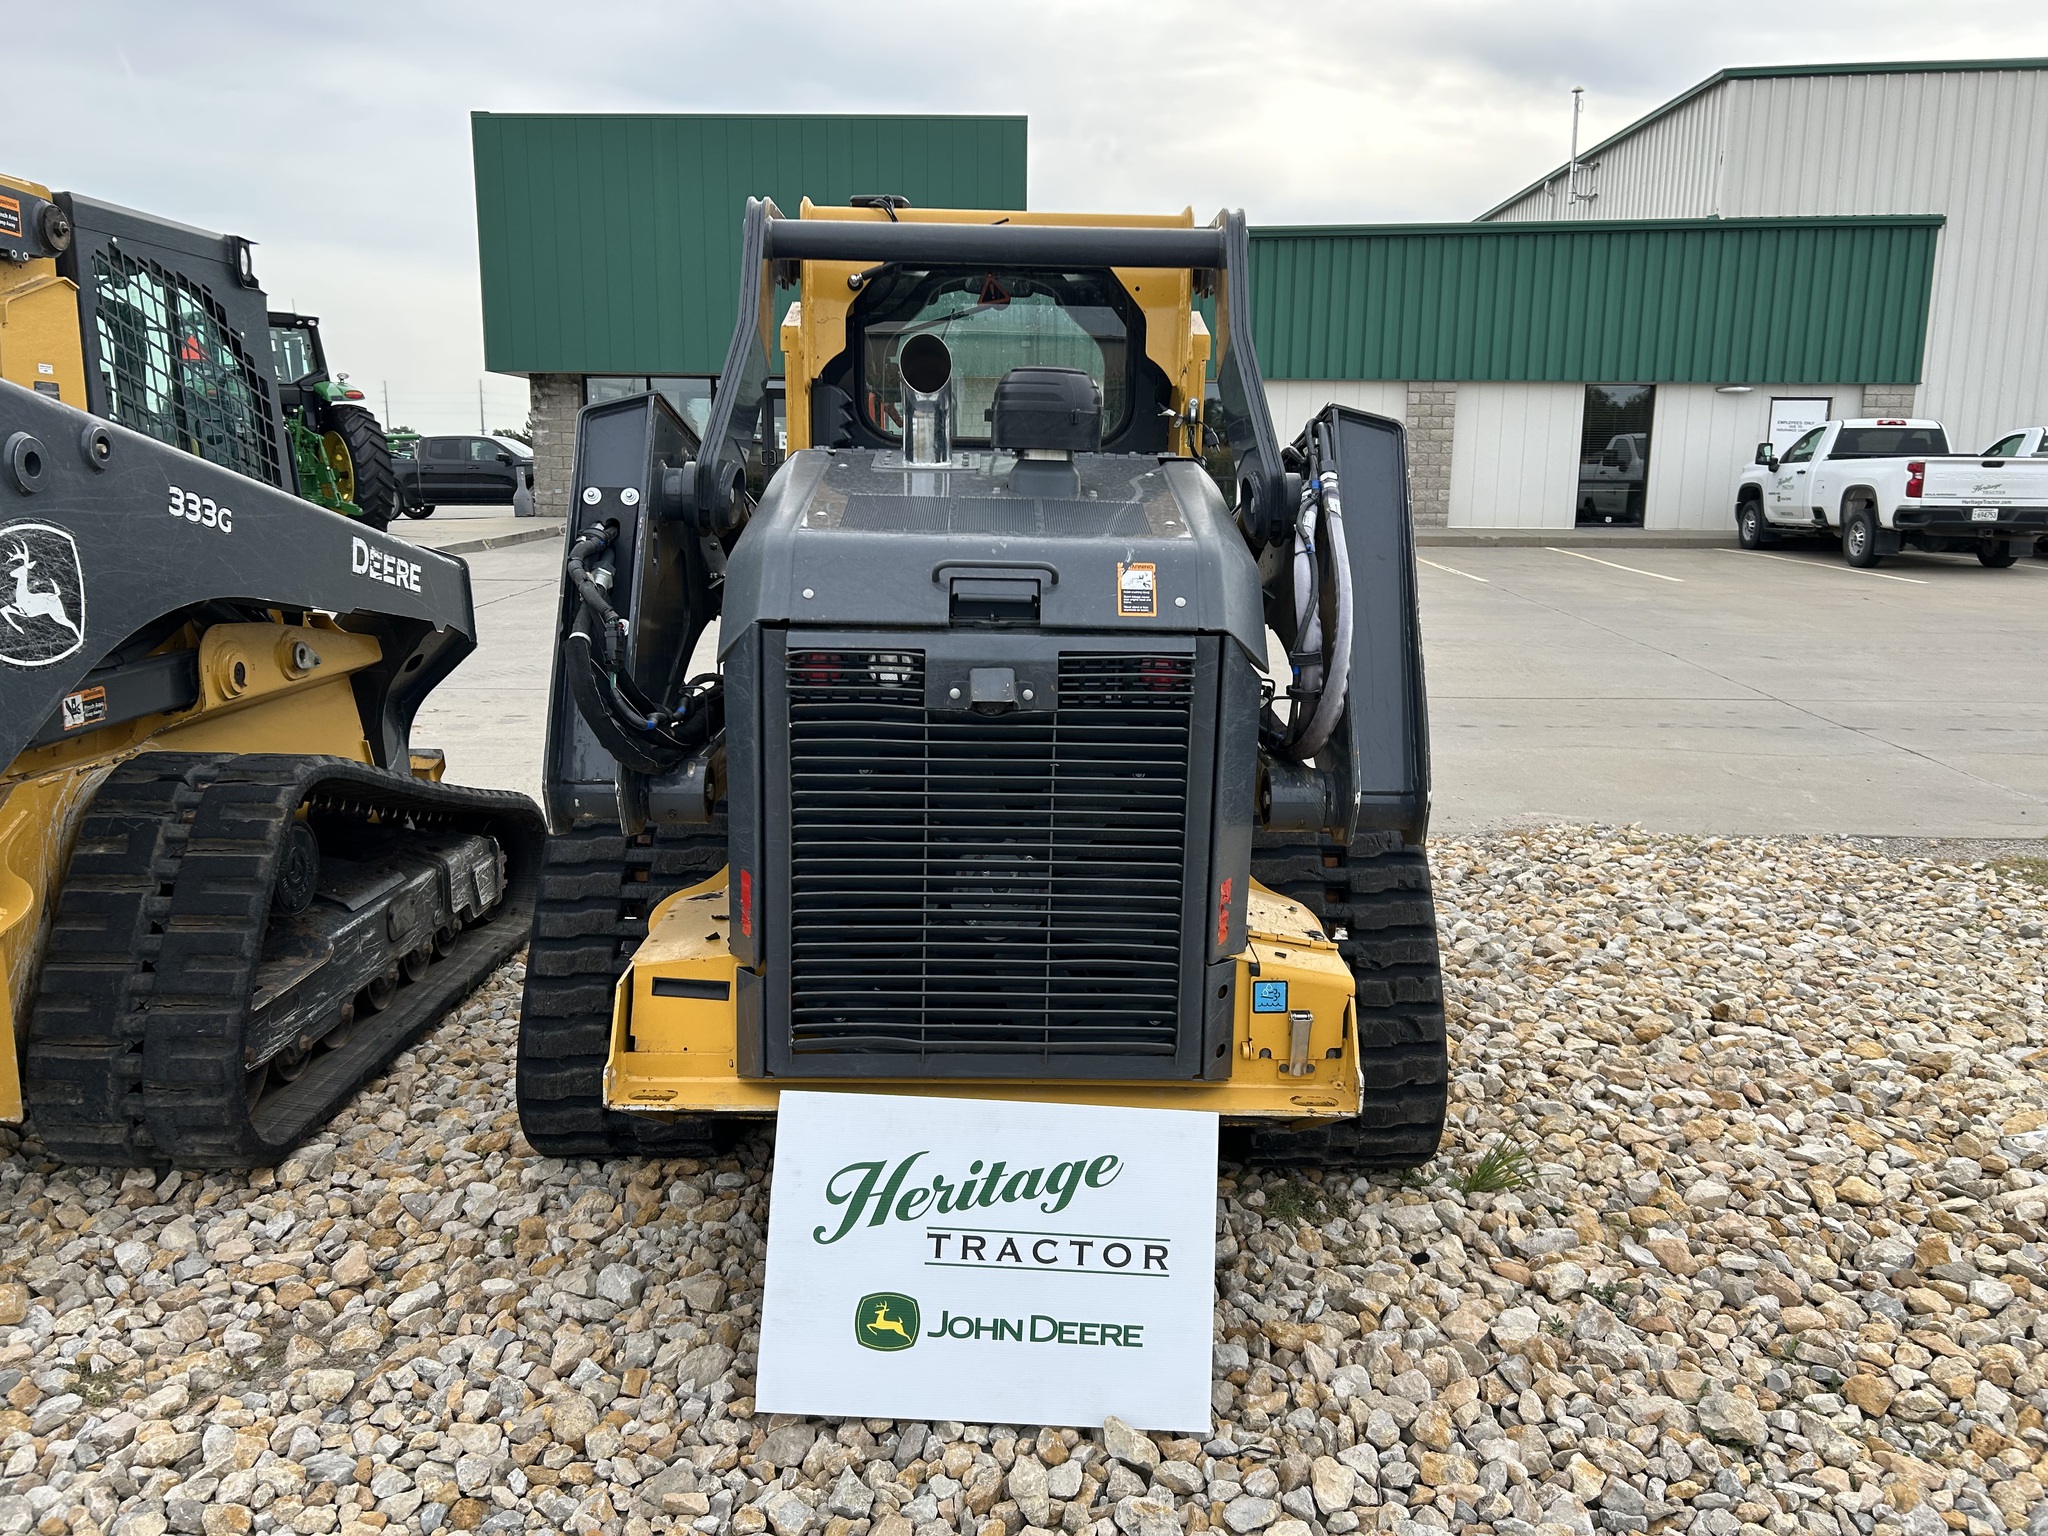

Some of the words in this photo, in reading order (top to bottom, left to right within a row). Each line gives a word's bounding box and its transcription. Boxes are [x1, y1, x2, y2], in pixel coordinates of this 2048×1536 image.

[168, 486, 232, 533] 333G
[1971, 483, 2002, 493] Heritage
[352, 536, 422, 593] DEERE
[813, 1150, 1124, 1245] Heritage
[926, 1232, 1169, 1271] TRACTOR
[927, 1310, 1024, 1342] JOHN
[1030, 1314, 1144, 1348] DEERE
